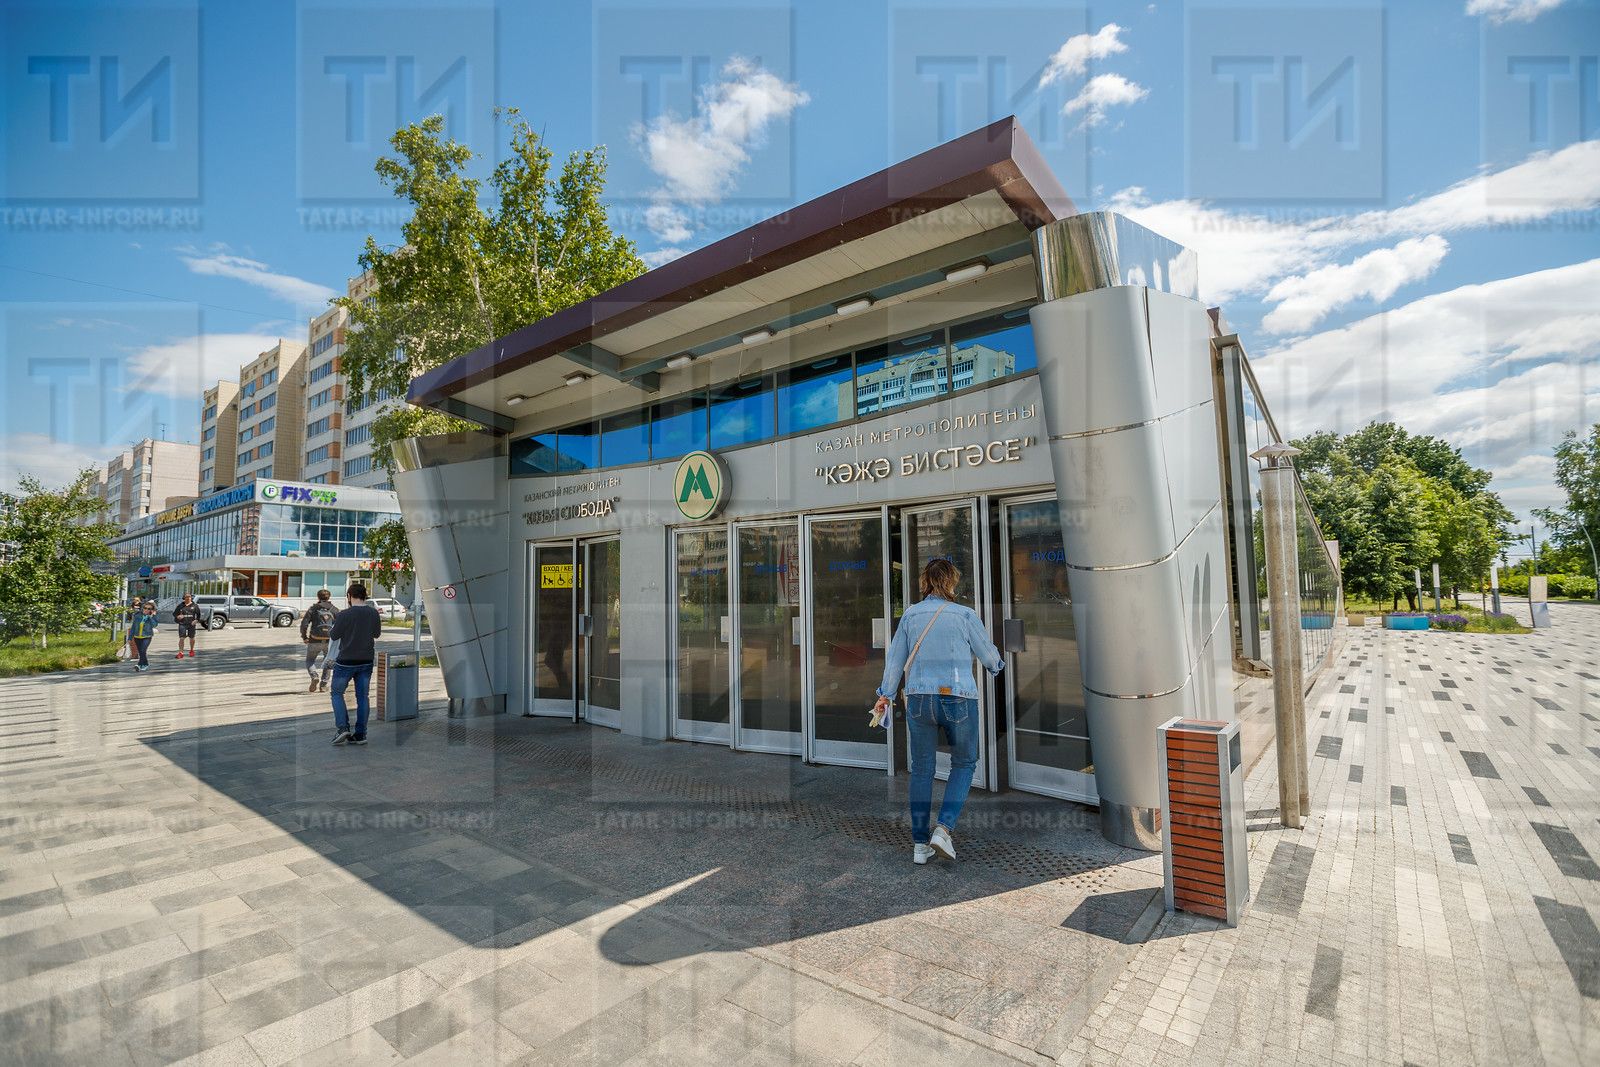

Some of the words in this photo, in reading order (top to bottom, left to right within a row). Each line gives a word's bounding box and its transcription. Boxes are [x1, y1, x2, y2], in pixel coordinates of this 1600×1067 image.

[815, 433, 864, 454] КАЗАН
[870, 404, 1036, 444] МЕТРОПОЛИТЕНЫ
[524, 485, 563, 503] КАЗАНСКИЙ
